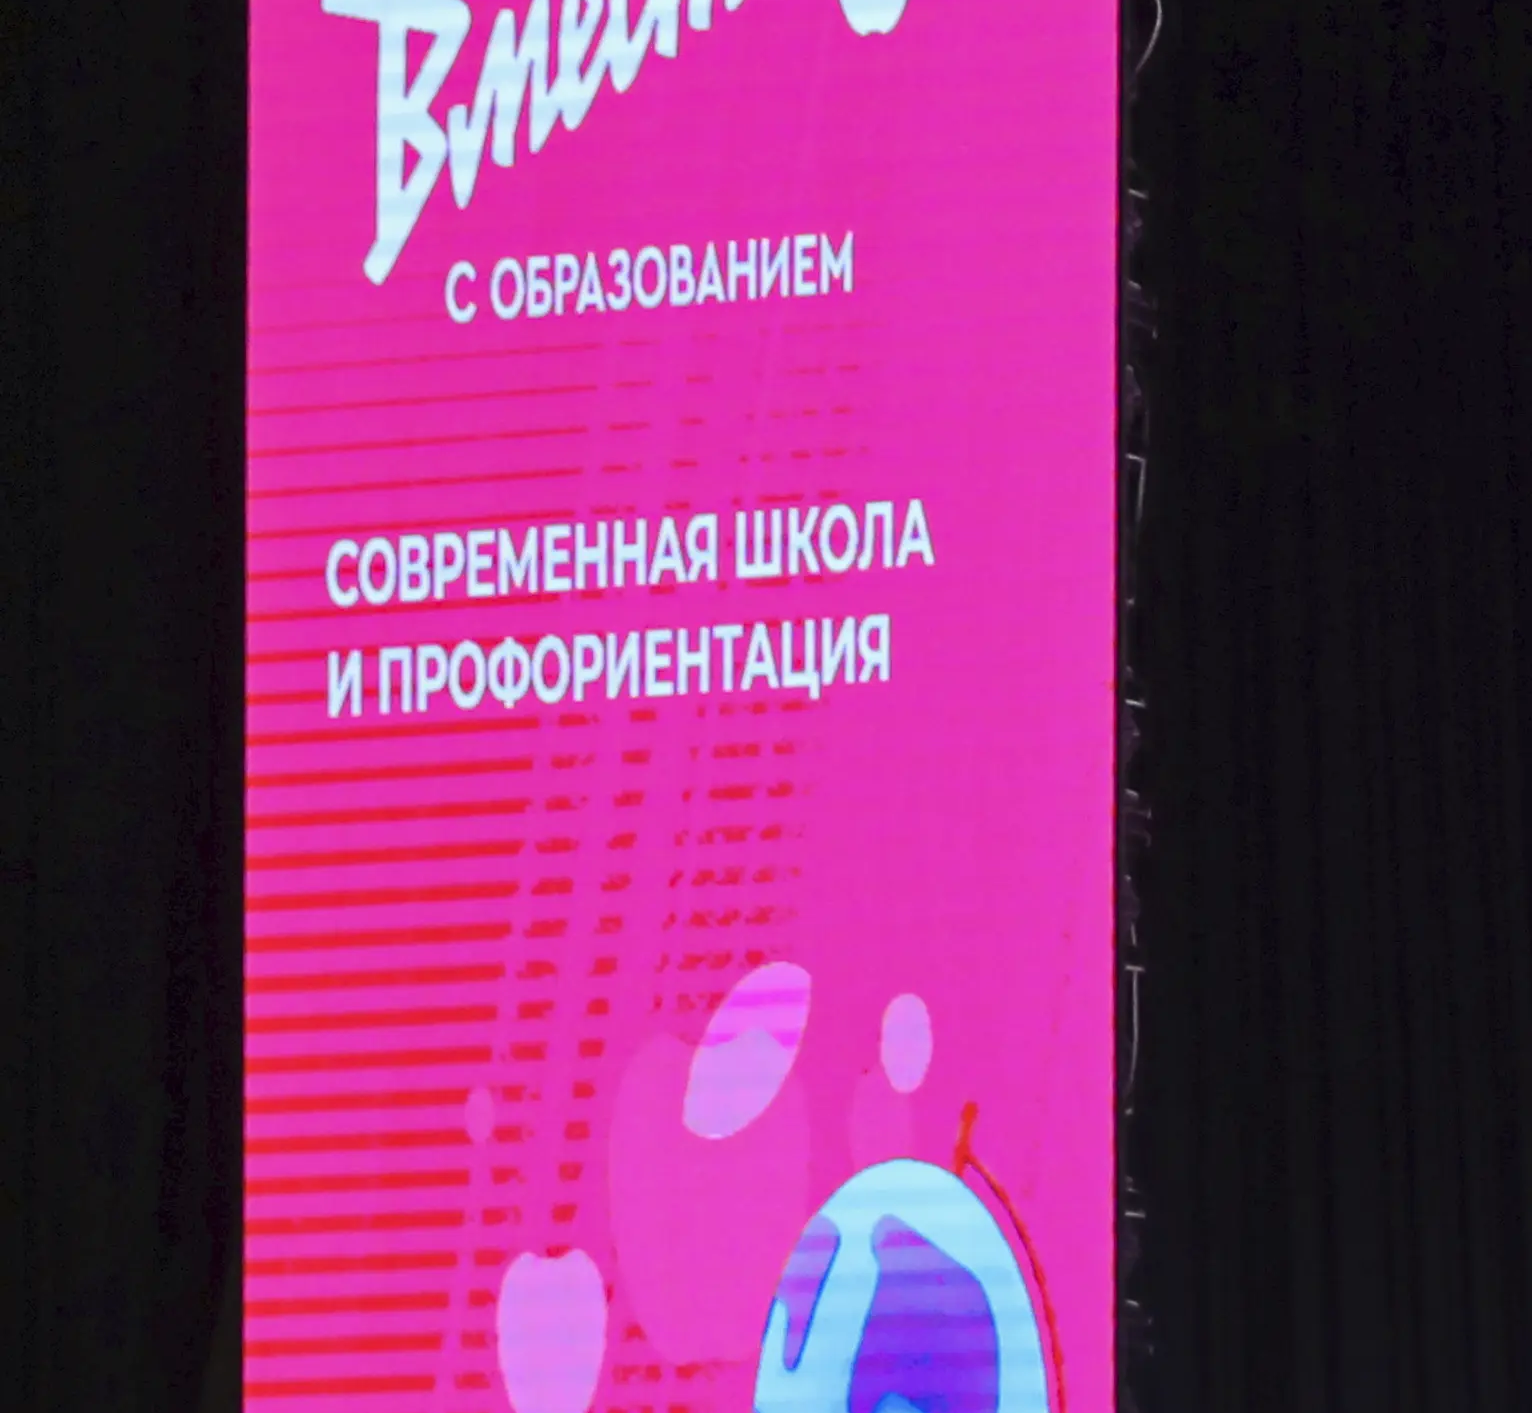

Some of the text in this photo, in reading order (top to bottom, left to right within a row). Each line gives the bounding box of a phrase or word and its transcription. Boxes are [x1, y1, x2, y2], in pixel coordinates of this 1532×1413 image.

[446, 231, 853, 324] С ОБРАЗОВАНИЕМ
[326, 499, 934, 607] СОВРЕМЕННАЯ ШКОЛА
[328, 613, 890, 718] И ПРОФОРИЕНТАЦИЯ
